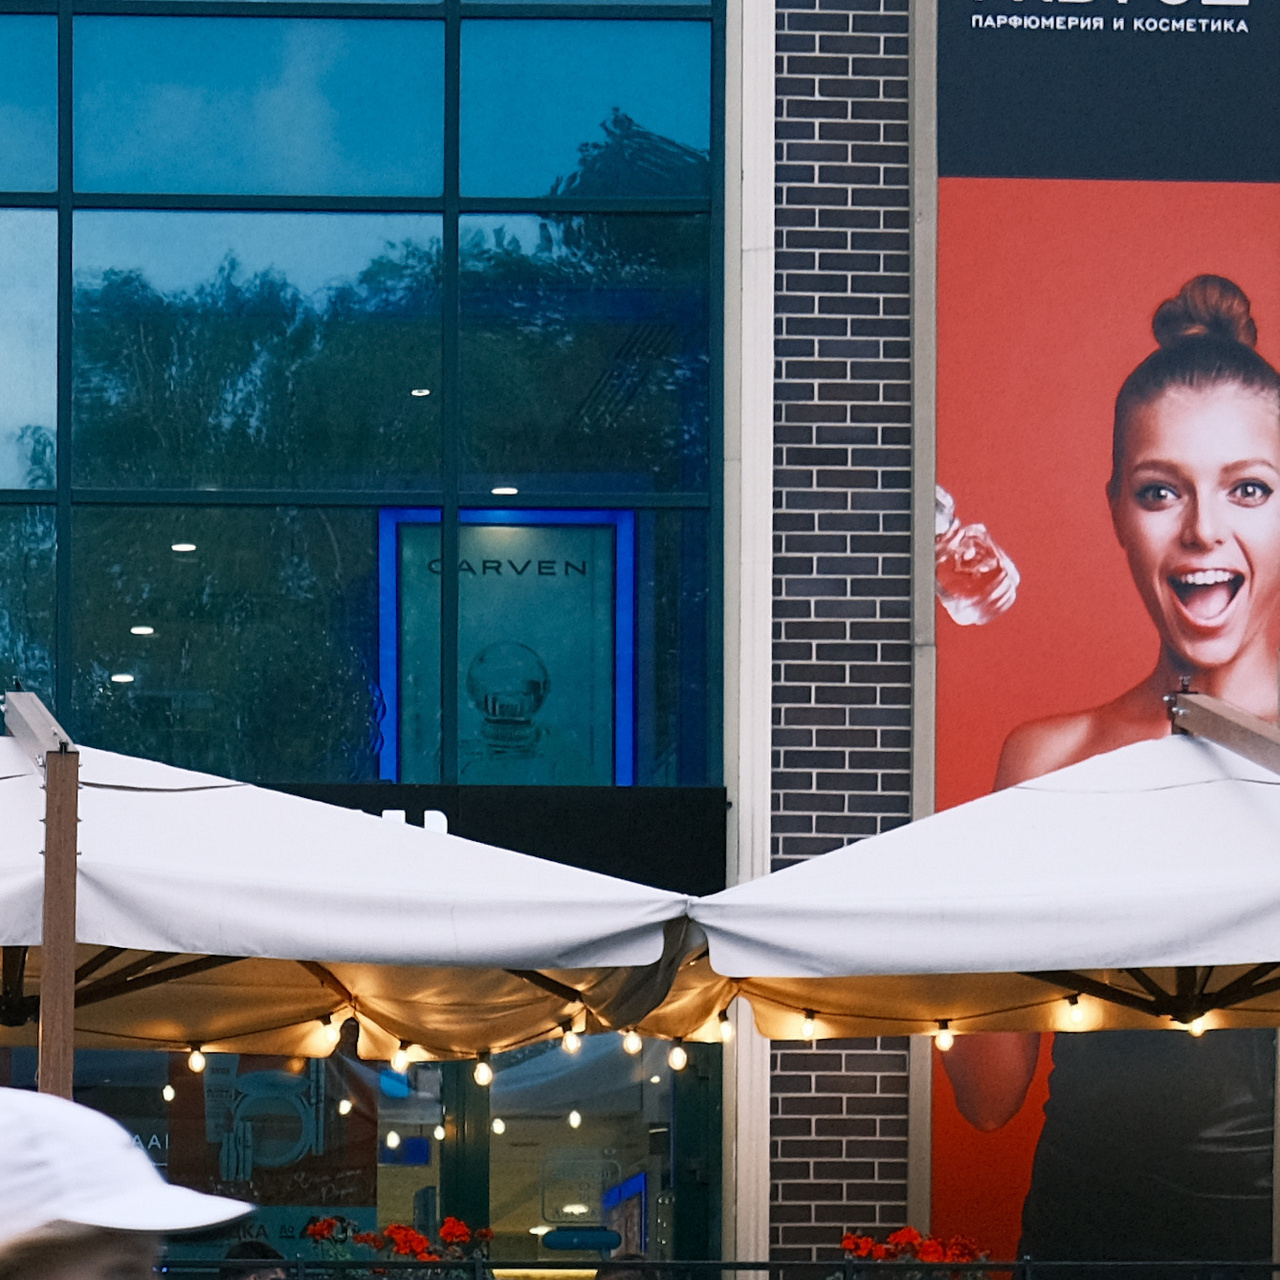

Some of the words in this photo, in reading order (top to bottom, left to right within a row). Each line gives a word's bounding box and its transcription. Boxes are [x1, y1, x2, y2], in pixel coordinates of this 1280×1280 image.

[971, 14, 1104, 31] ПАРФЮМЕРИЯ
[1113, 17, 1124, 31] И
[1133, 18, 1249, 33] КОСМЕТИКА
[428, 559, 586, 576] CARVEN
